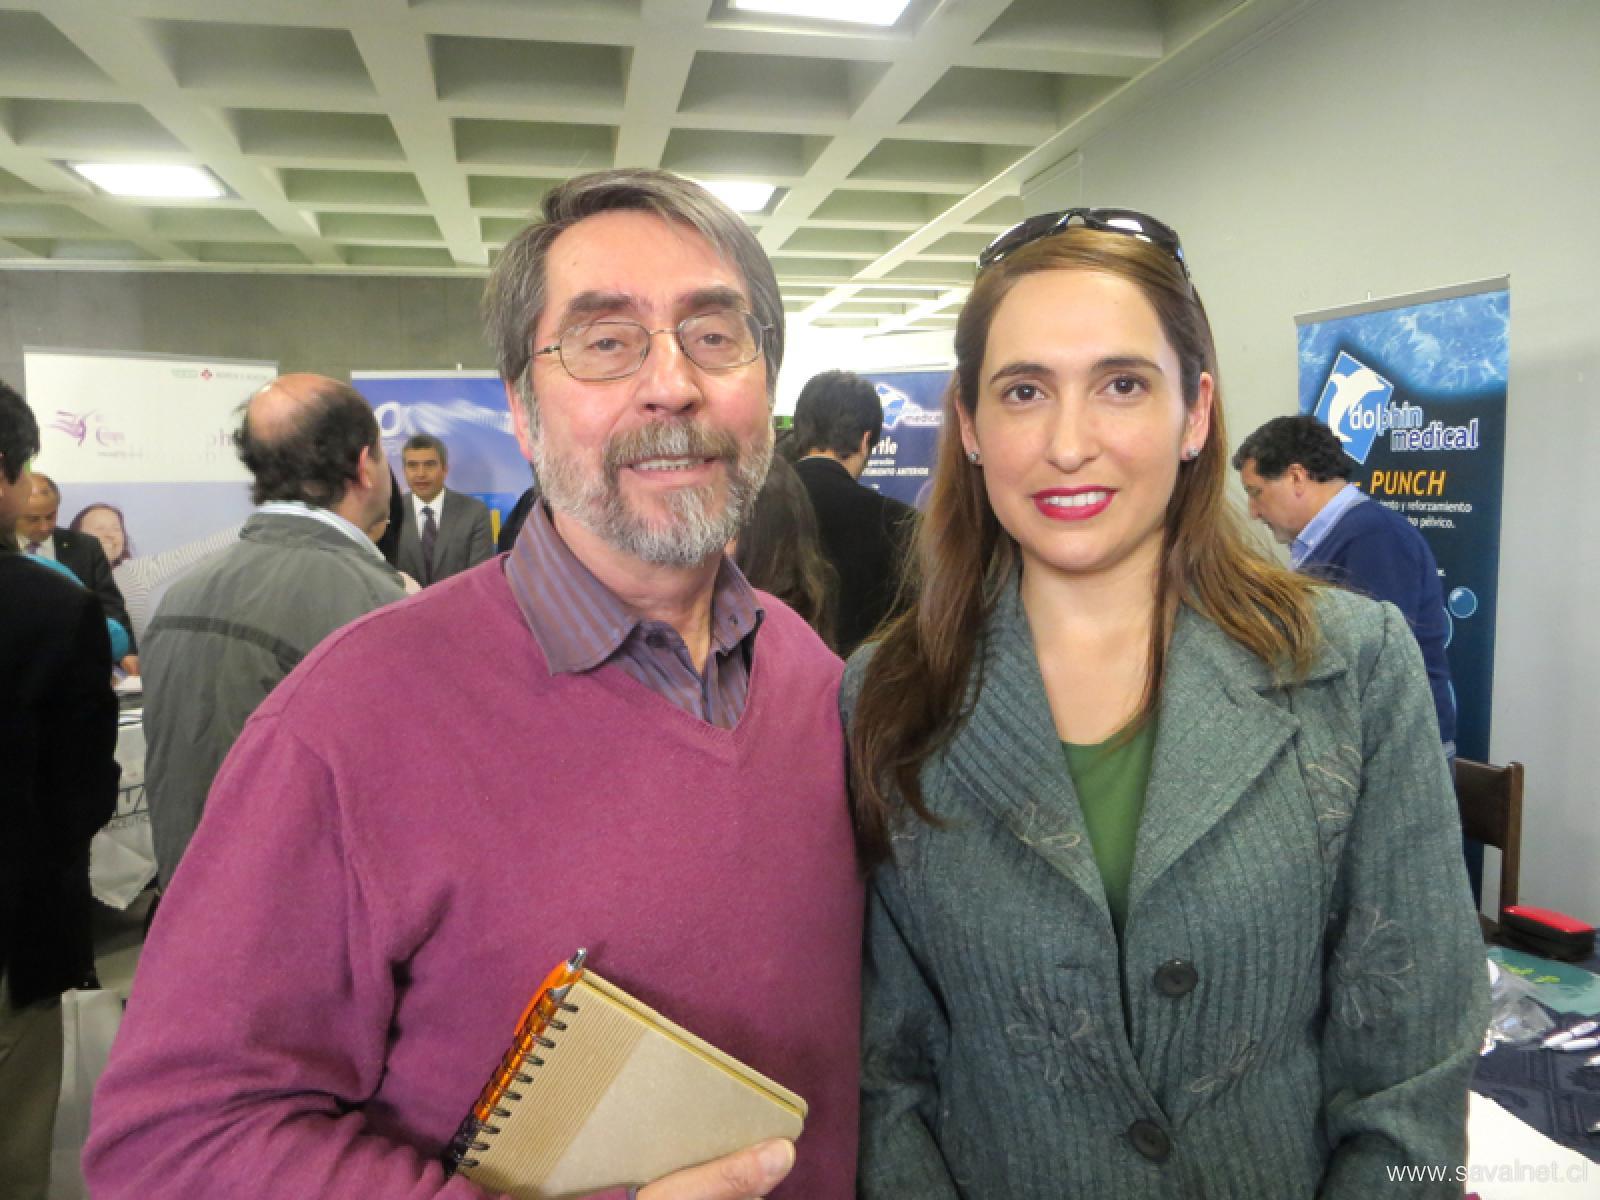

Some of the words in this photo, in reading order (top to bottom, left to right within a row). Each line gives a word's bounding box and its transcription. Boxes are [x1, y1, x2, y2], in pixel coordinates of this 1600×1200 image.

[1349, 400, 1424, 436] dolphin
[1391, 417, 1480, 451] medical
[1369, 469, 1447, 496] PUNCH
